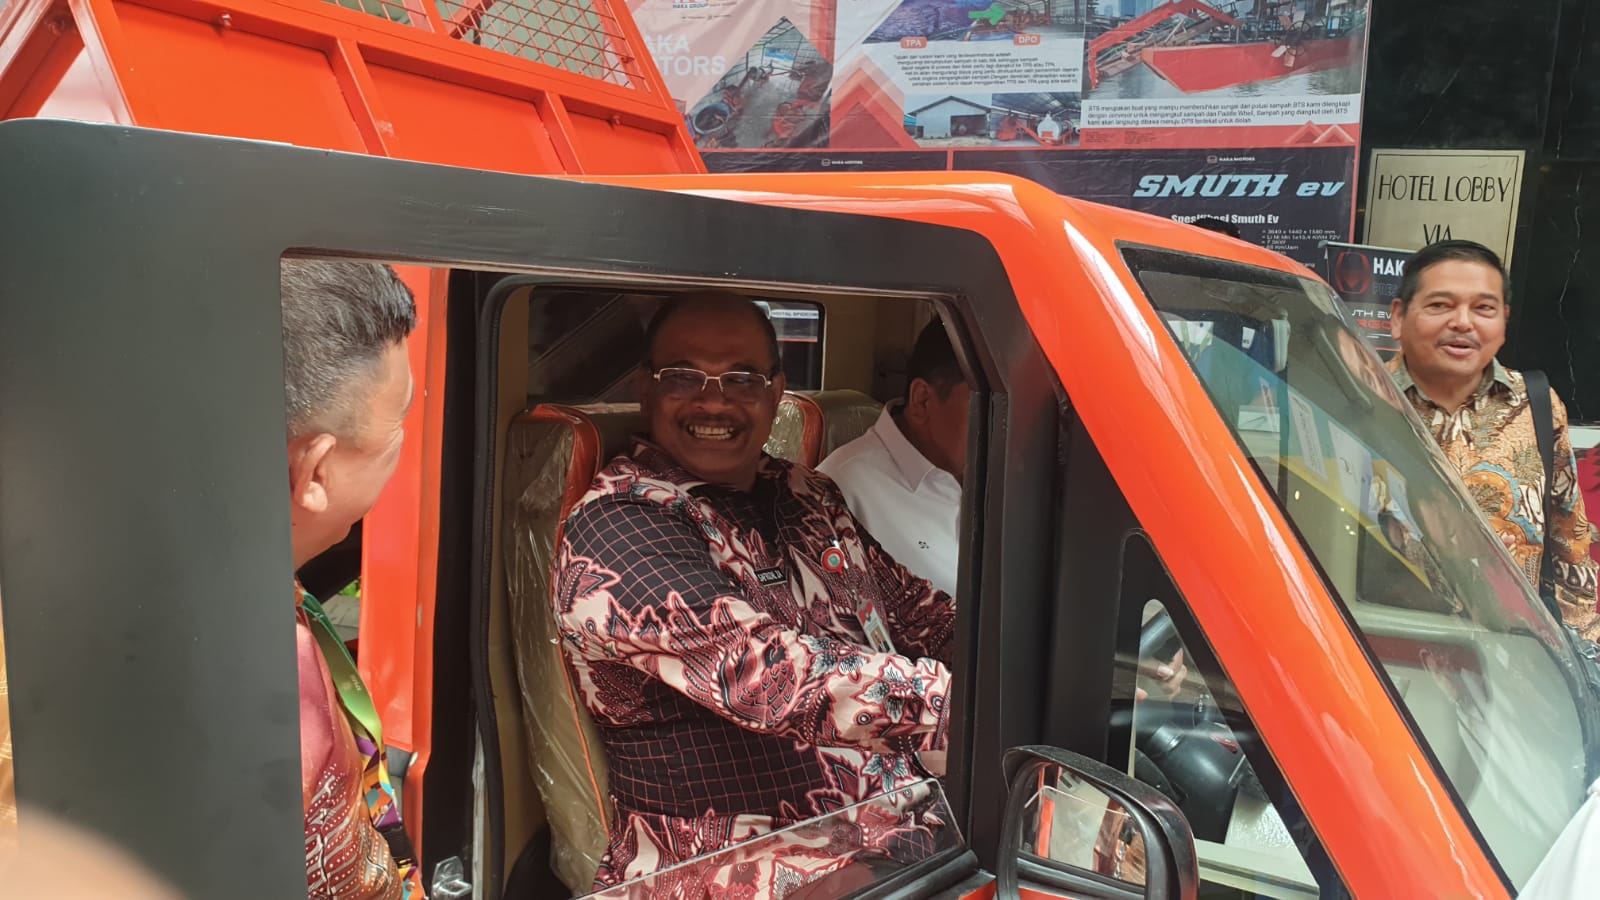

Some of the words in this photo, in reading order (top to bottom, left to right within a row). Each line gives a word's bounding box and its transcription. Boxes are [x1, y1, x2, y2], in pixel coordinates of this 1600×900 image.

[905, 38, 922, 47] TPA
[1132, 174, 1288, 198] SMUTH
[1296, 181, 1345, 198] ev
[1378, 174, 1438, 201] HOTEL
[1444, 175, 1512, 202] LOBBY
[1231, 214, 1265, 224] Smuth
[1267, 214, 1279, 224] Ev
[1423, 224, 1452, 246] VIA
[1373, 256, 1405, 277] HAK
